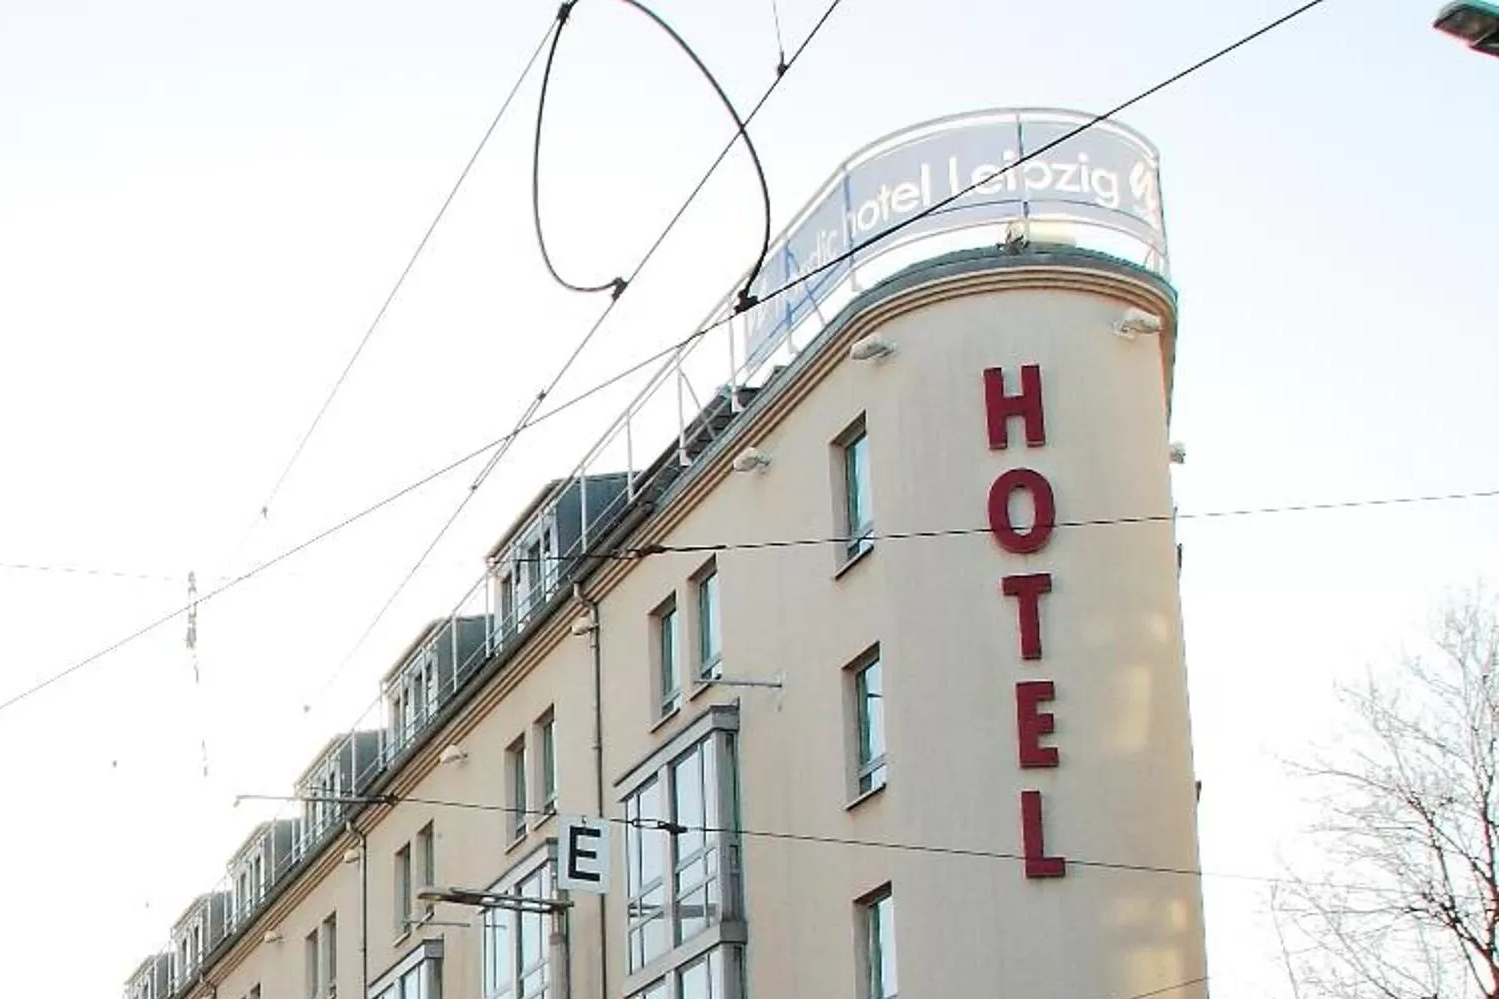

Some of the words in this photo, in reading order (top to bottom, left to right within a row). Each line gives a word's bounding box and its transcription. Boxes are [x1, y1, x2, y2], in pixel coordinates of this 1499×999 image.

[948, 150, 1119, 208] Leipzig
[983, 364, 1066, 879] HOTEL
[567, 825, 602, 882] E
